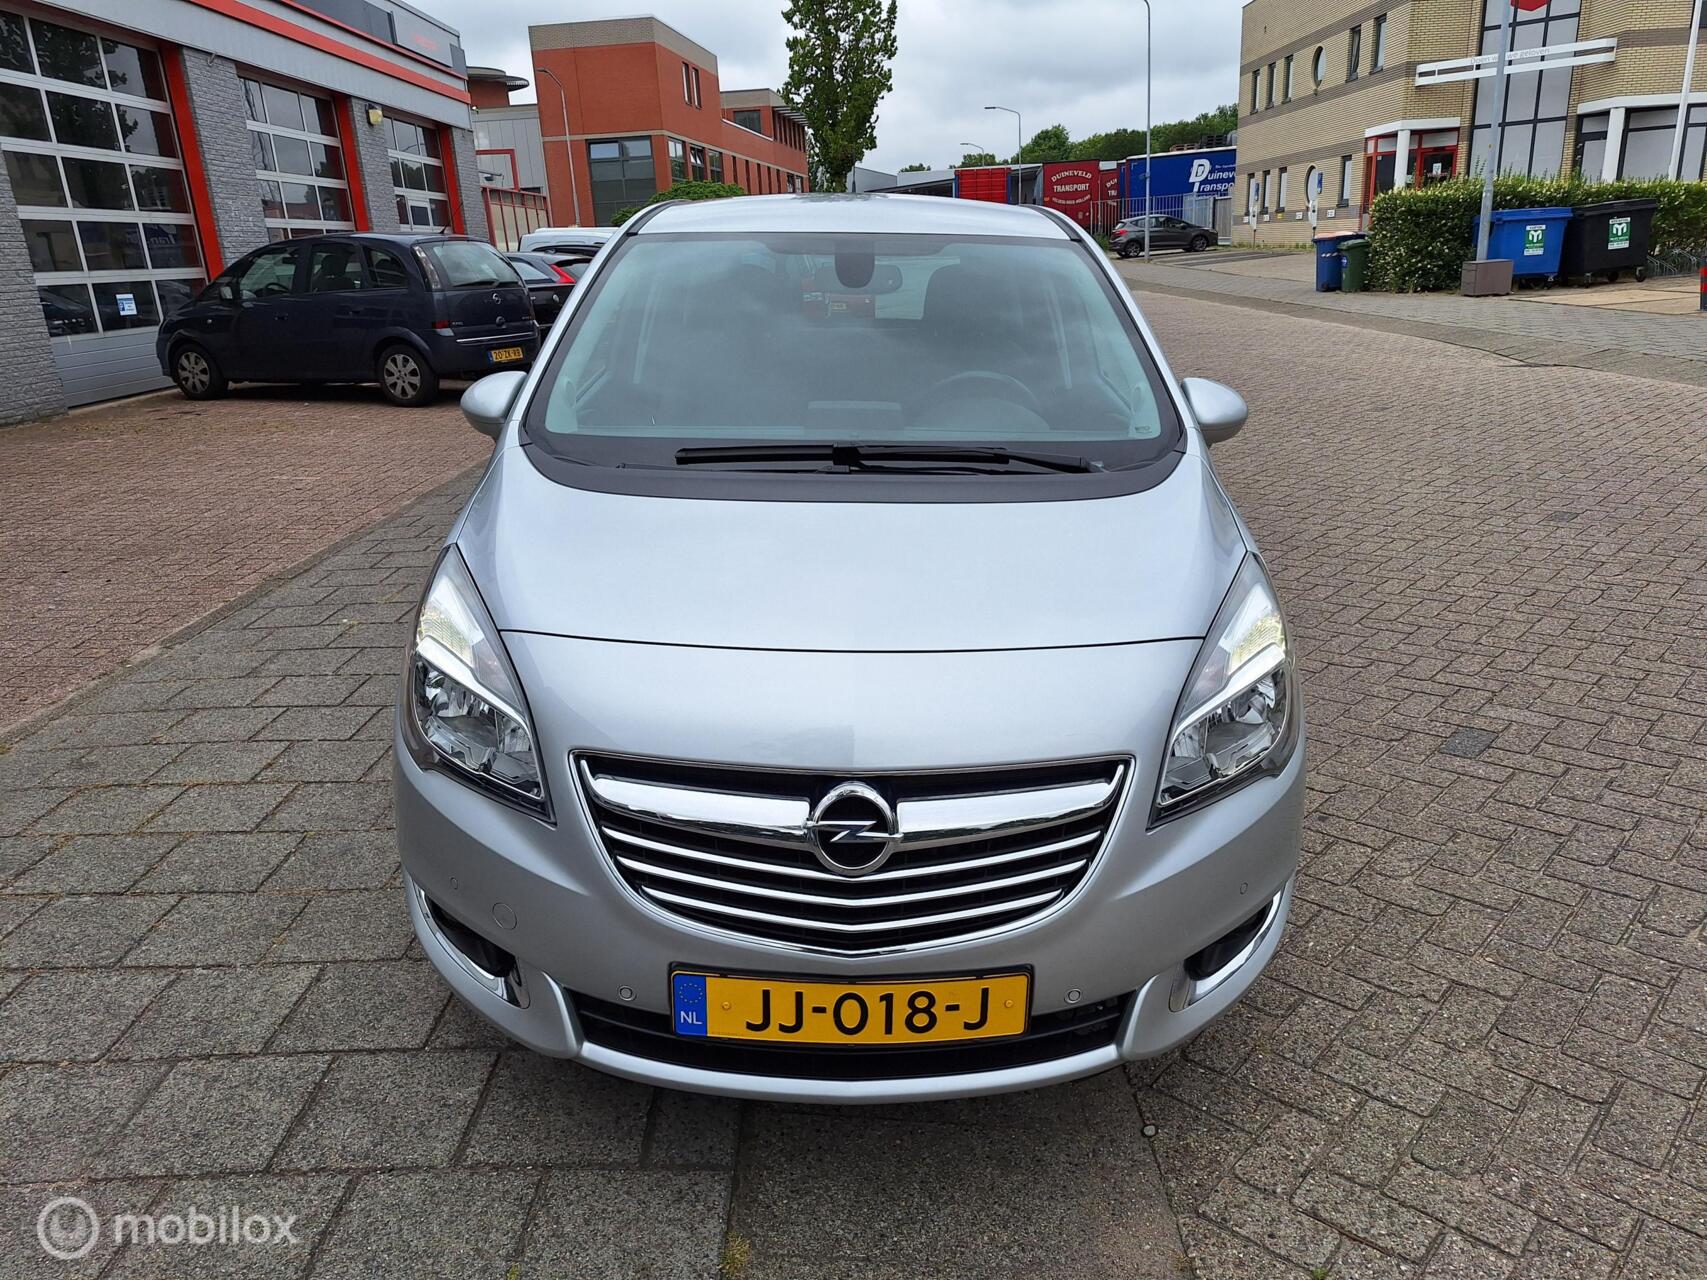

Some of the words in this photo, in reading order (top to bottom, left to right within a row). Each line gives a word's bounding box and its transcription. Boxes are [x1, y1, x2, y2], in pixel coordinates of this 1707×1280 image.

[1519, 47, 1550, 58] geloven
[1051, 170, 1092, 182] DUINEVELD
[1189, 159, 1236, 183] Duinev
[1053, 183, 1089, 193] TRANSPORT
[680, 1010, 702, 1025] NL
[746, 987, 989, 1035] JJ-018-J
